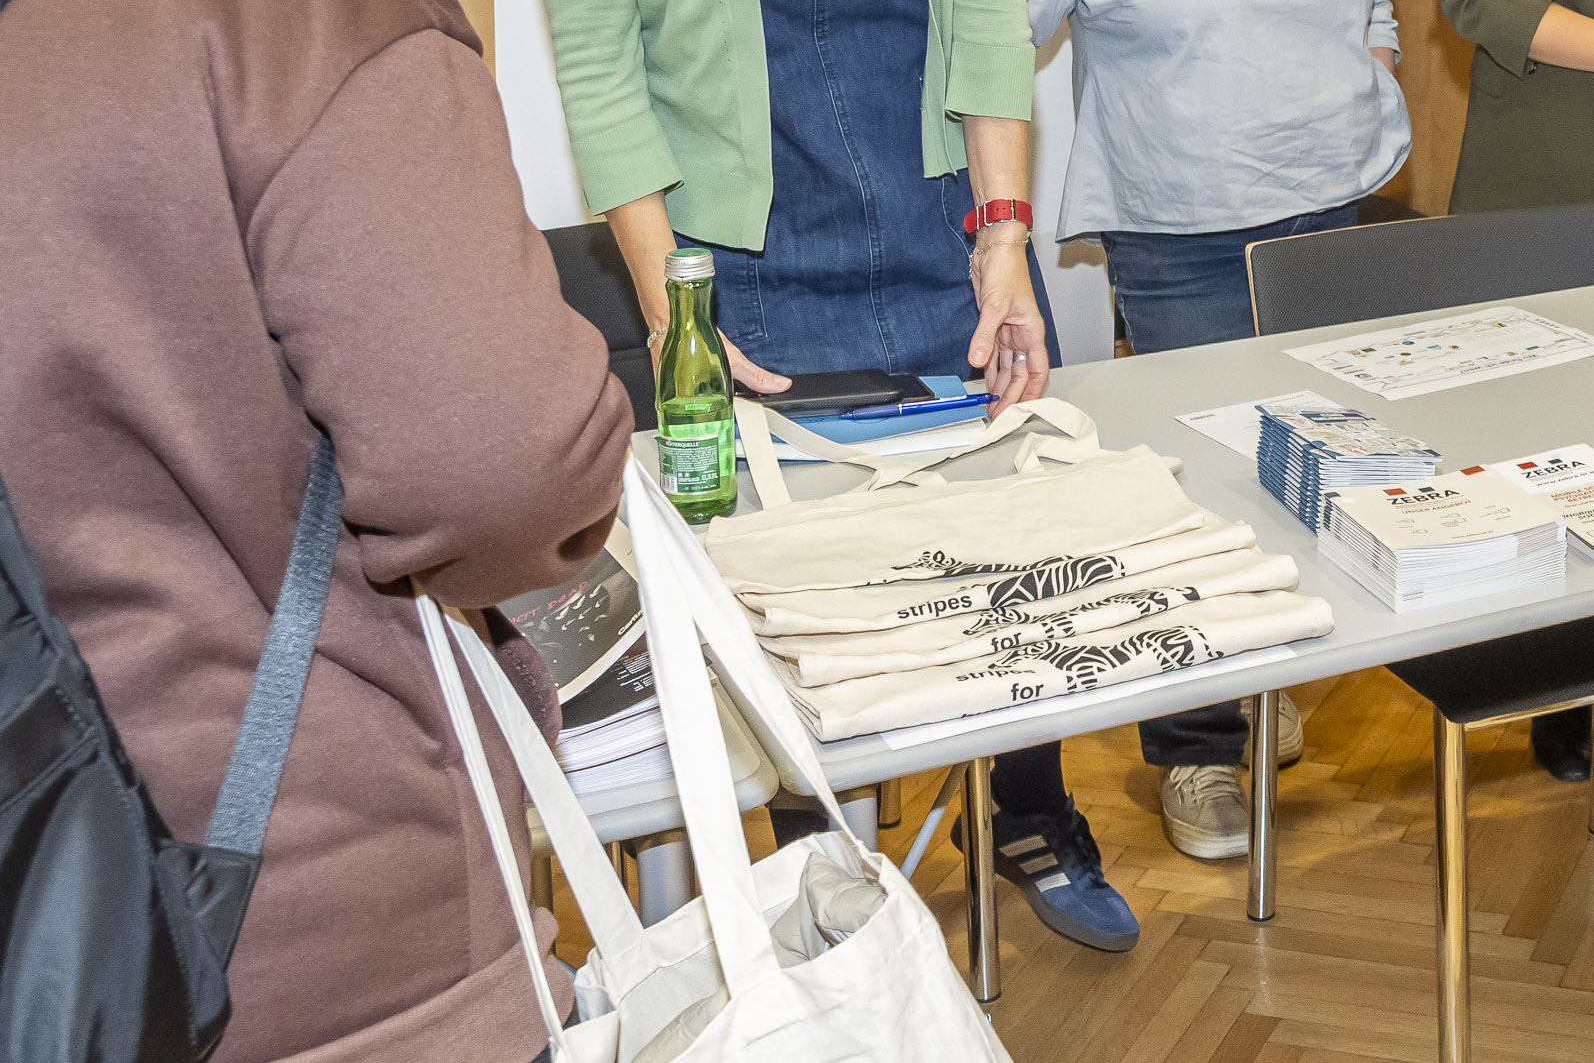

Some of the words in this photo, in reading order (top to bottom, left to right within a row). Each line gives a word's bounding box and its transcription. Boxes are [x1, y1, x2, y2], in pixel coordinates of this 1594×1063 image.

[1521, 461, 1586, 479] ZEBRA
[1387, 489, 1460, 505] ZEBRA
[1401, 506, 1431, 515] UNSER
[1432, 499, 1472, 511] ANGEBOT
[897, 593, 973, 620] stripes
[991, 631, 1022, 653] for
[1010, 682, 1044, 702] for
